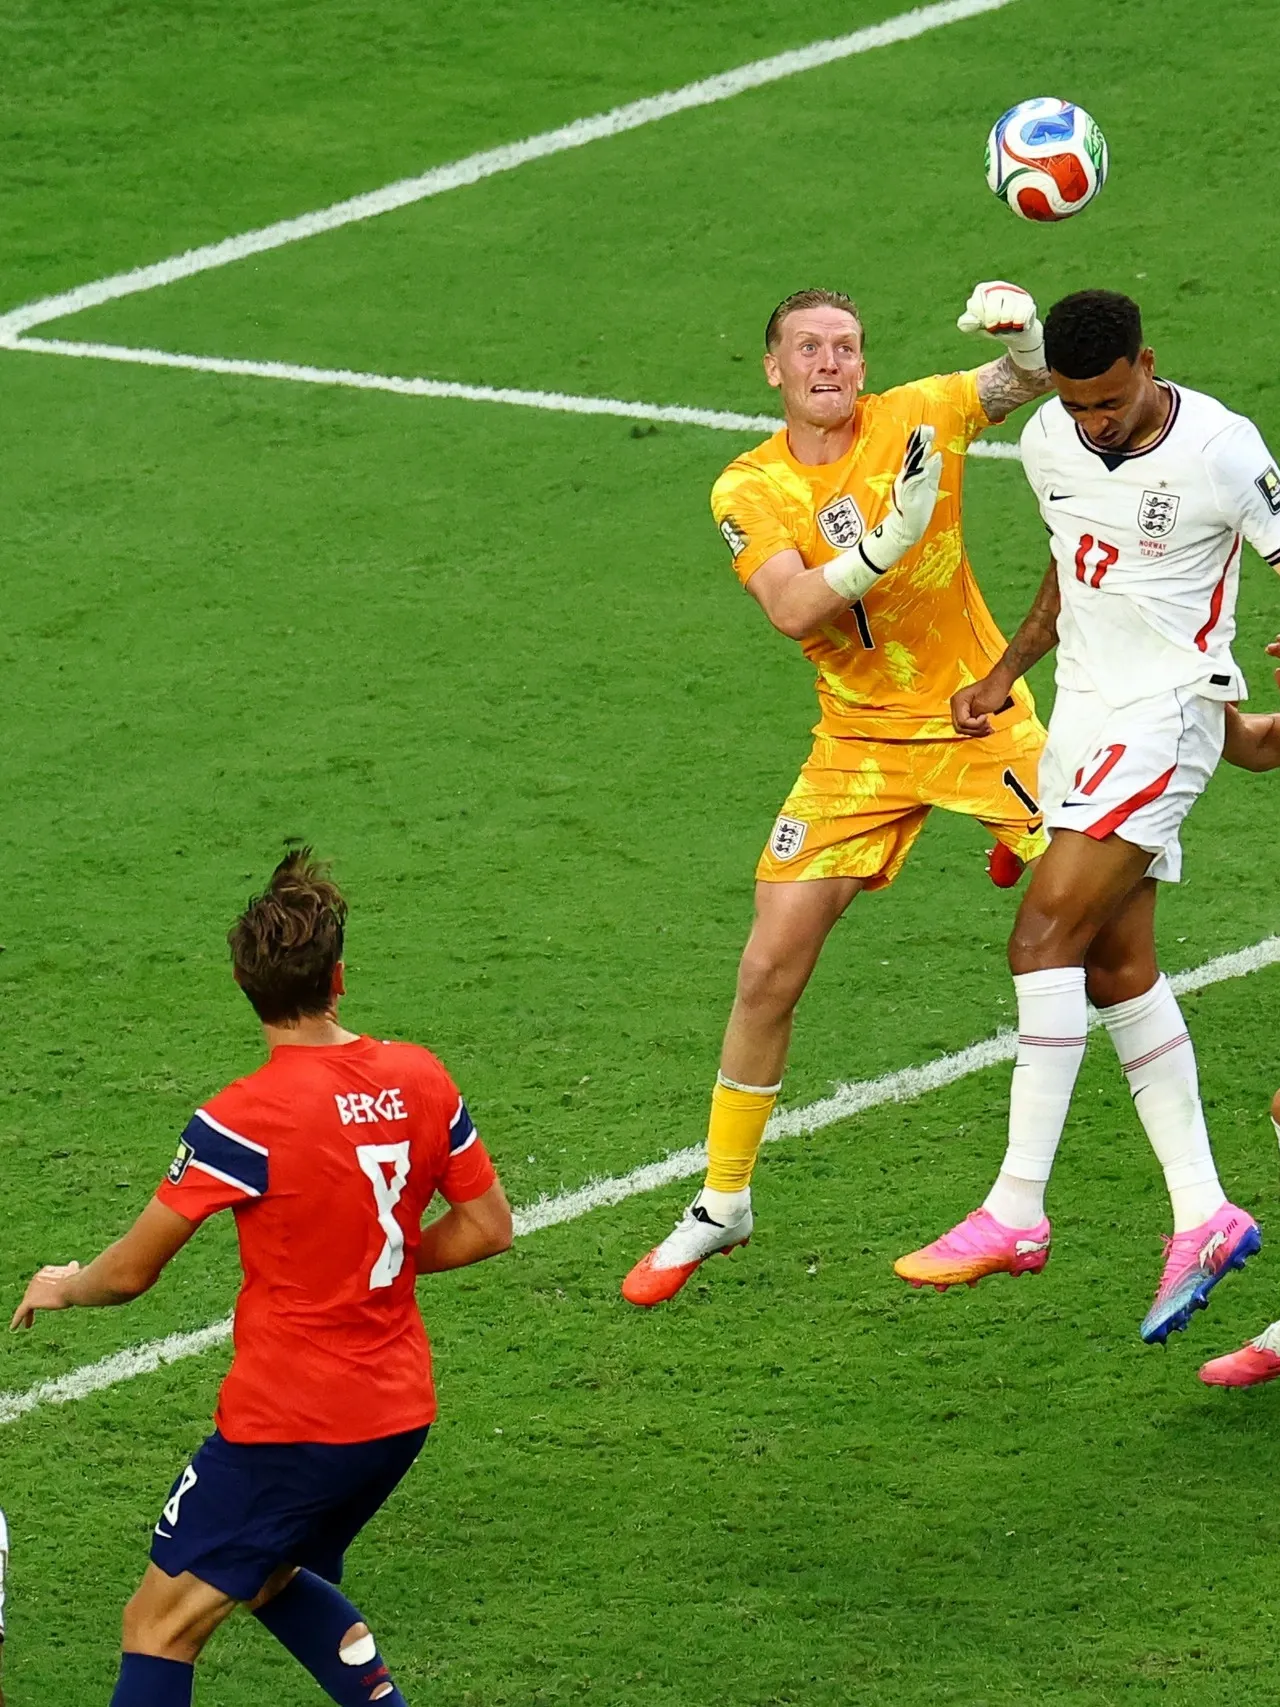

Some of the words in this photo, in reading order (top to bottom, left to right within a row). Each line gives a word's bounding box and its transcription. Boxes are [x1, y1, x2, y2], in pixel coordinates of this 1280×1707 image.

[1075, 533, 1119, 589] 17
[1002, 766, 1040, 817] 1
[334, 1088, 408, 1125] BERGE
[163, 1464, 198, 1527] 8
